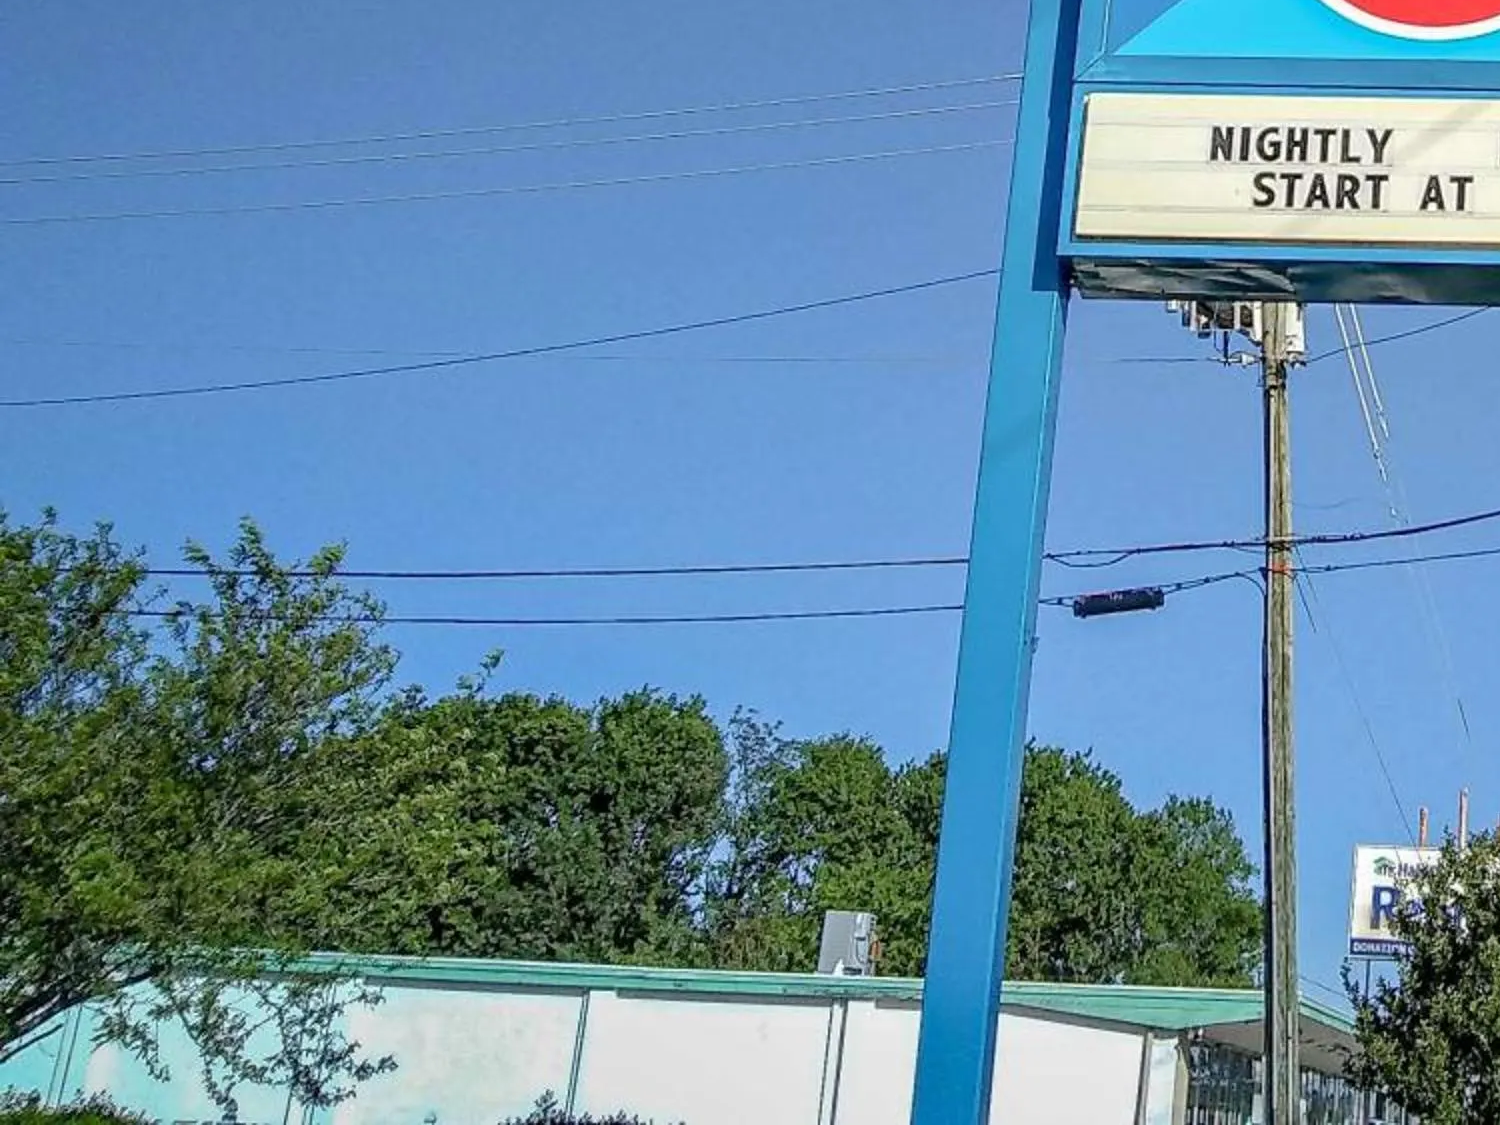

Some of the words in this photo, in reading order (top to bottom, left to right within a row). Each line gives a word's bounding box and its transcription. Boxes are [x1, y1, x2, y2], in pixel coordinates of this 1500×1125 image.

[1210, 126, 1394, 164] NIGHTLY
[1252, 172, 1390, 211] START
[1420, 175, 1475, 212] AT
